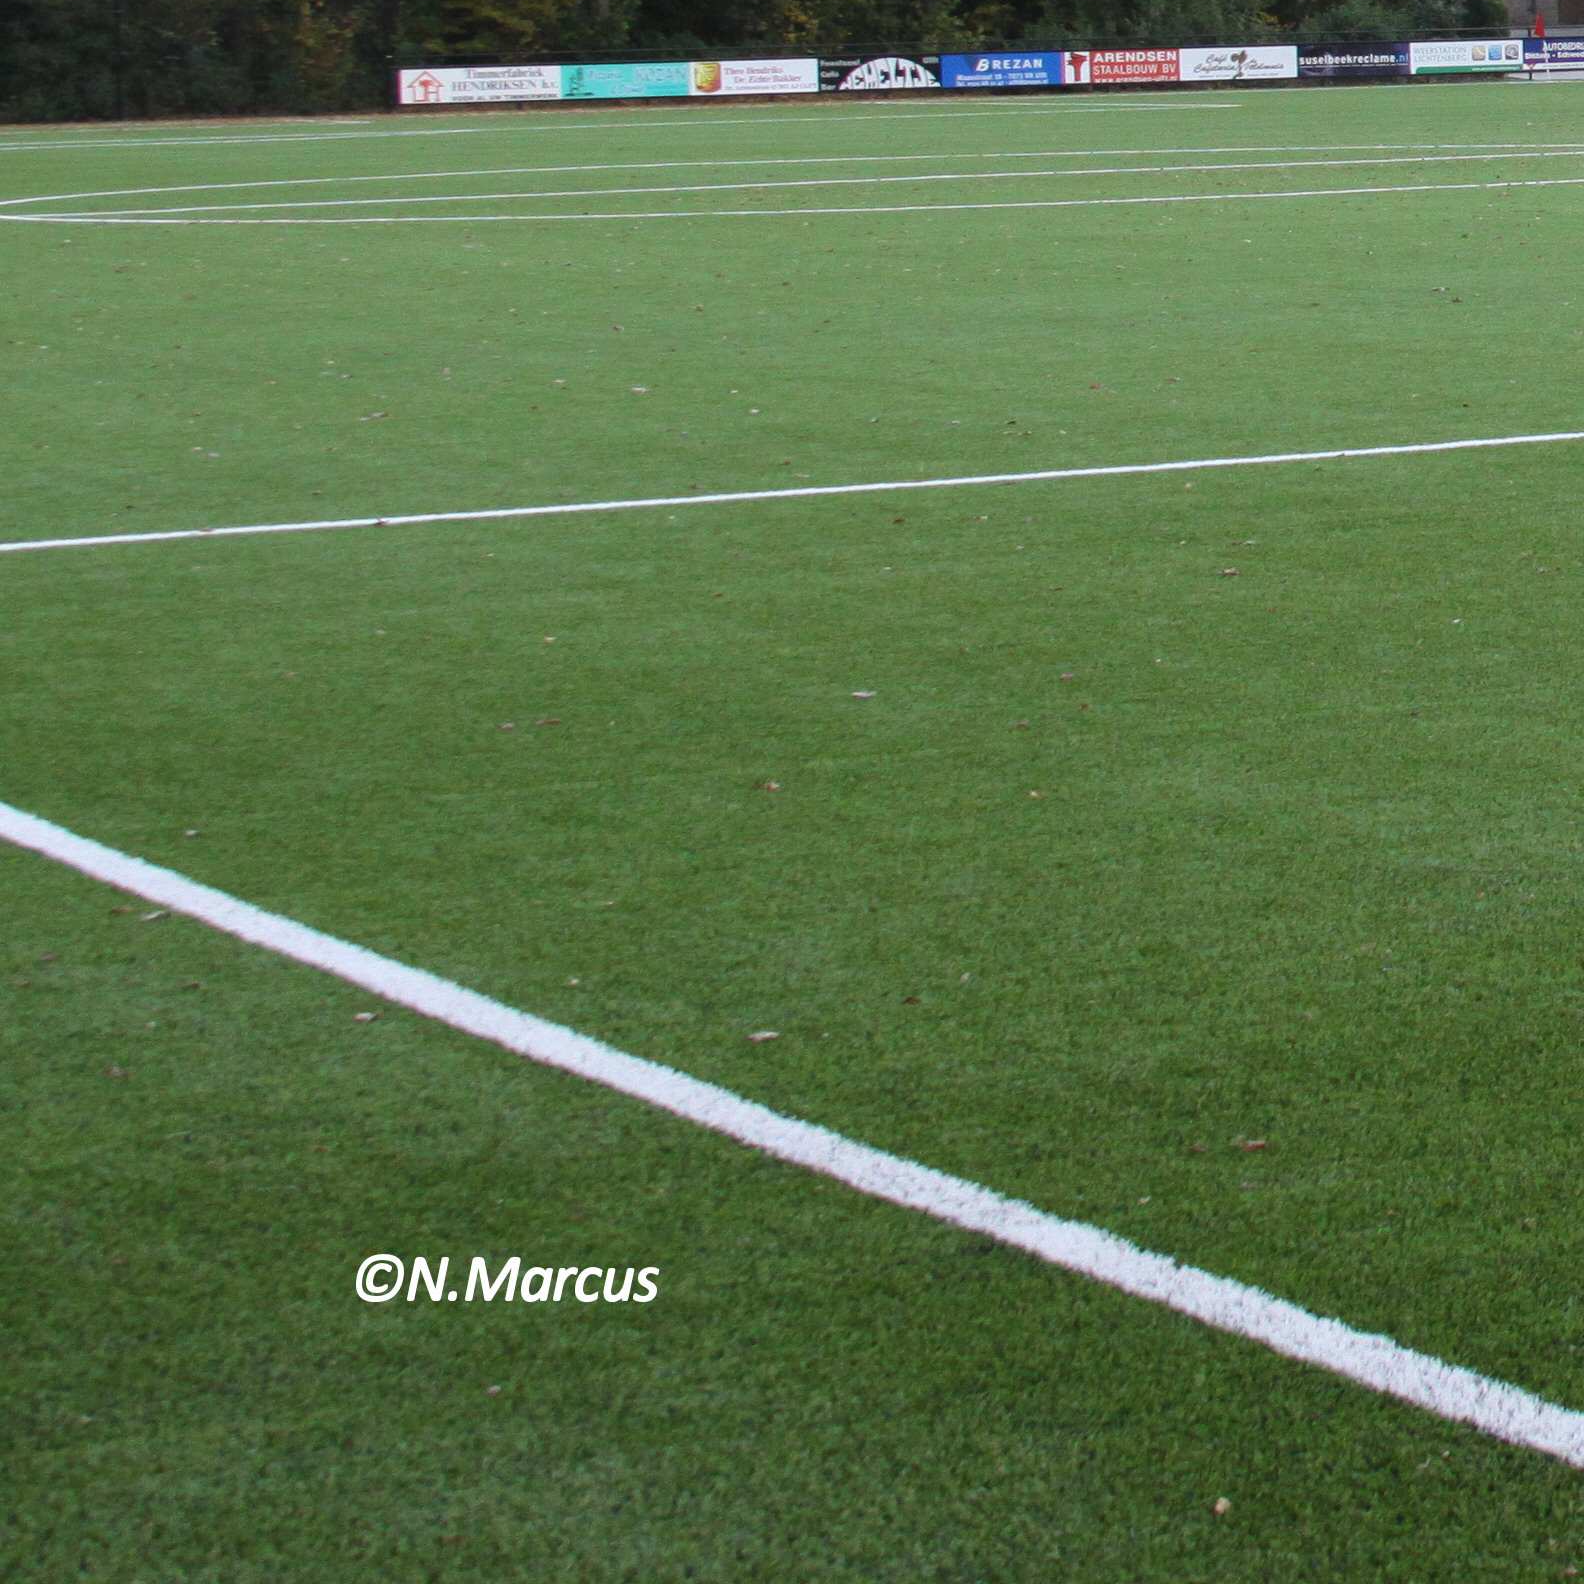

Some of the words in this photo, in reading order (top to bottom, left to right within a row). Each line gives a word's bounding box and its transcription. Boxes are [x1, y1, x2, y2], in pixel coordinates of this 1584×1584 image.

[1094, 51, 1177, 63] ARENDSEN
[1299, 52, 1409, 65] suselbeekreclame.nl
[975, 58, 1043, 72] BREZAN
[1094, 63, 1157, 75] STAALBOUW
[1162, 63, 1176, 73] BV
[466, 67, 545, 80] Timmerfabriek
[451, 79, 537, 92] HENDRIKSEN
